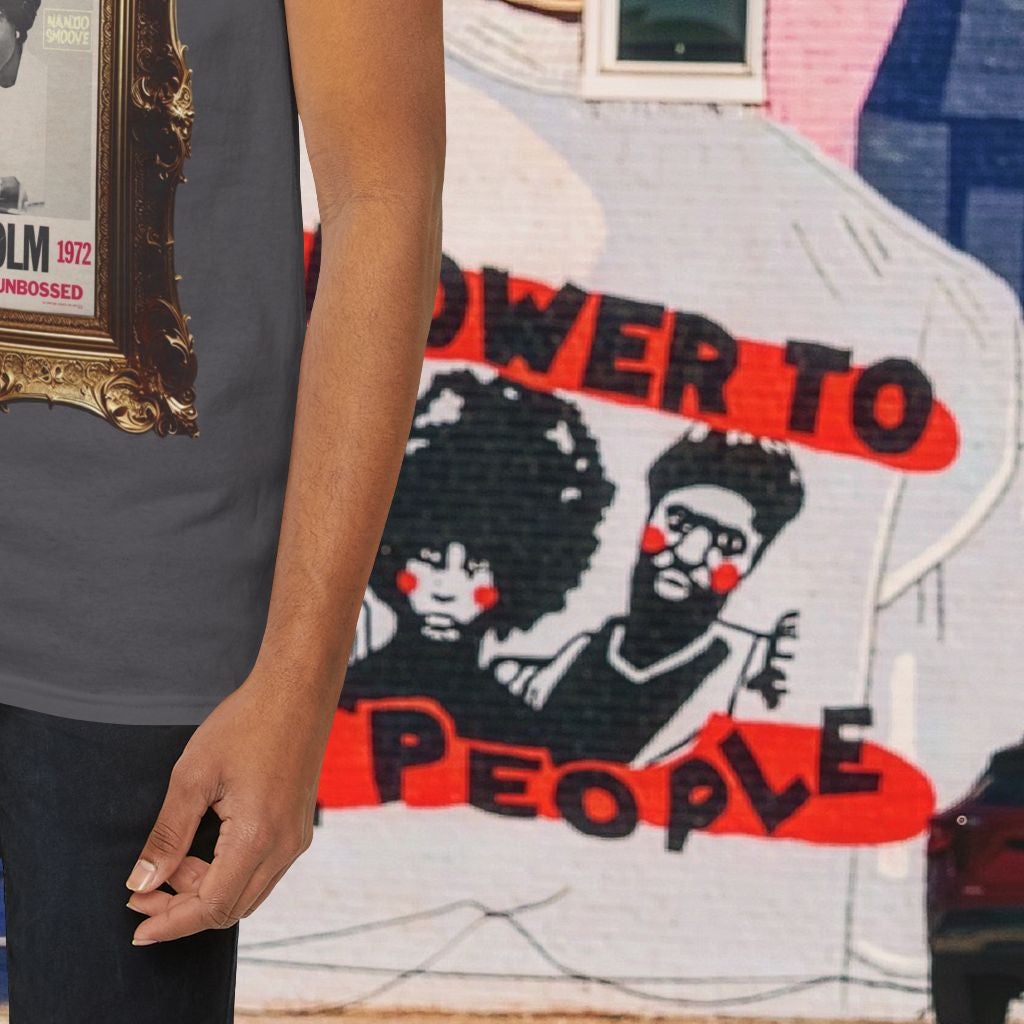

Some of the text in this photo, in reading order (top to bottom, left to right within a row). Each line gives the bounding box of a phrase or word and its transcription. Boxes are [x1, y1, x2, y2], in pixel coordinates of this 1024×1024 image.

[57, 240, 92, 266] 1972
[783, 339, 936, 454] TO
[367, 704, 882, 854] PEOPLE
